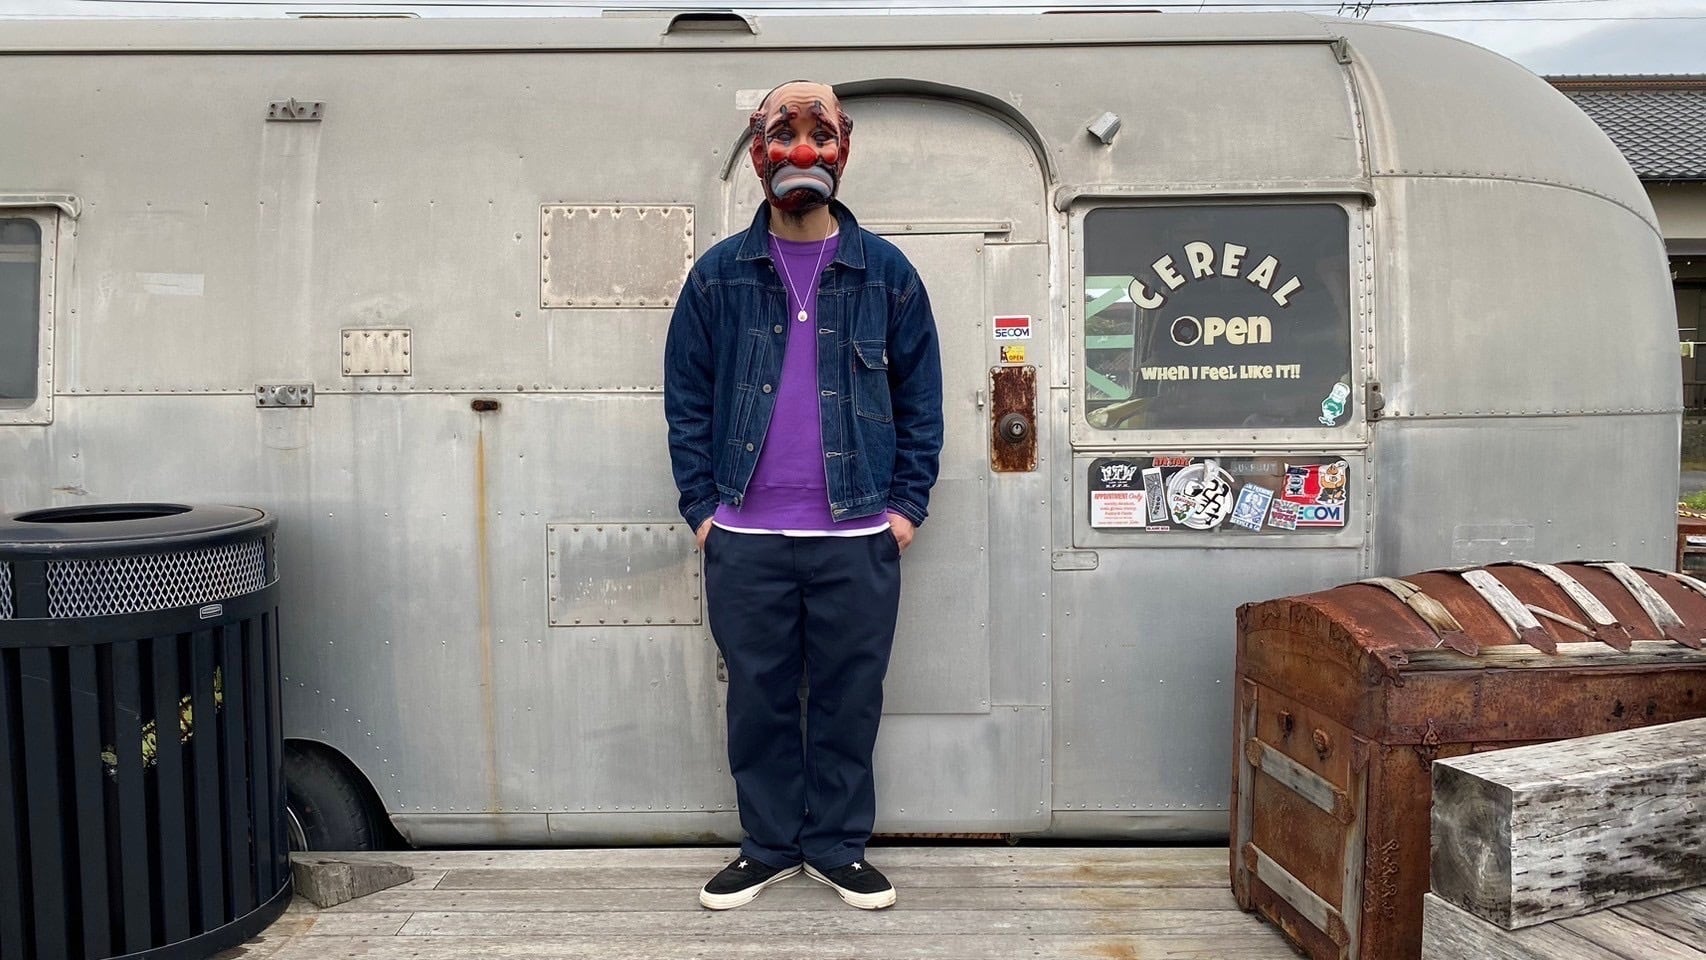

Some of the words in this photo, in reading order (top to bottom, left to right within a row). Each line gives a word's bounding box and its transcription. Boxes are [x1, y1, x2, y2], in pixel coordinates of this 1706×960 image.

[1128, 241, 1302, 310] CEREAL
[995, 328, 1030, 337] SECOM
[1129, 493, 1143, 502] Only
[1298, 506, 1340, 520] ECOM
